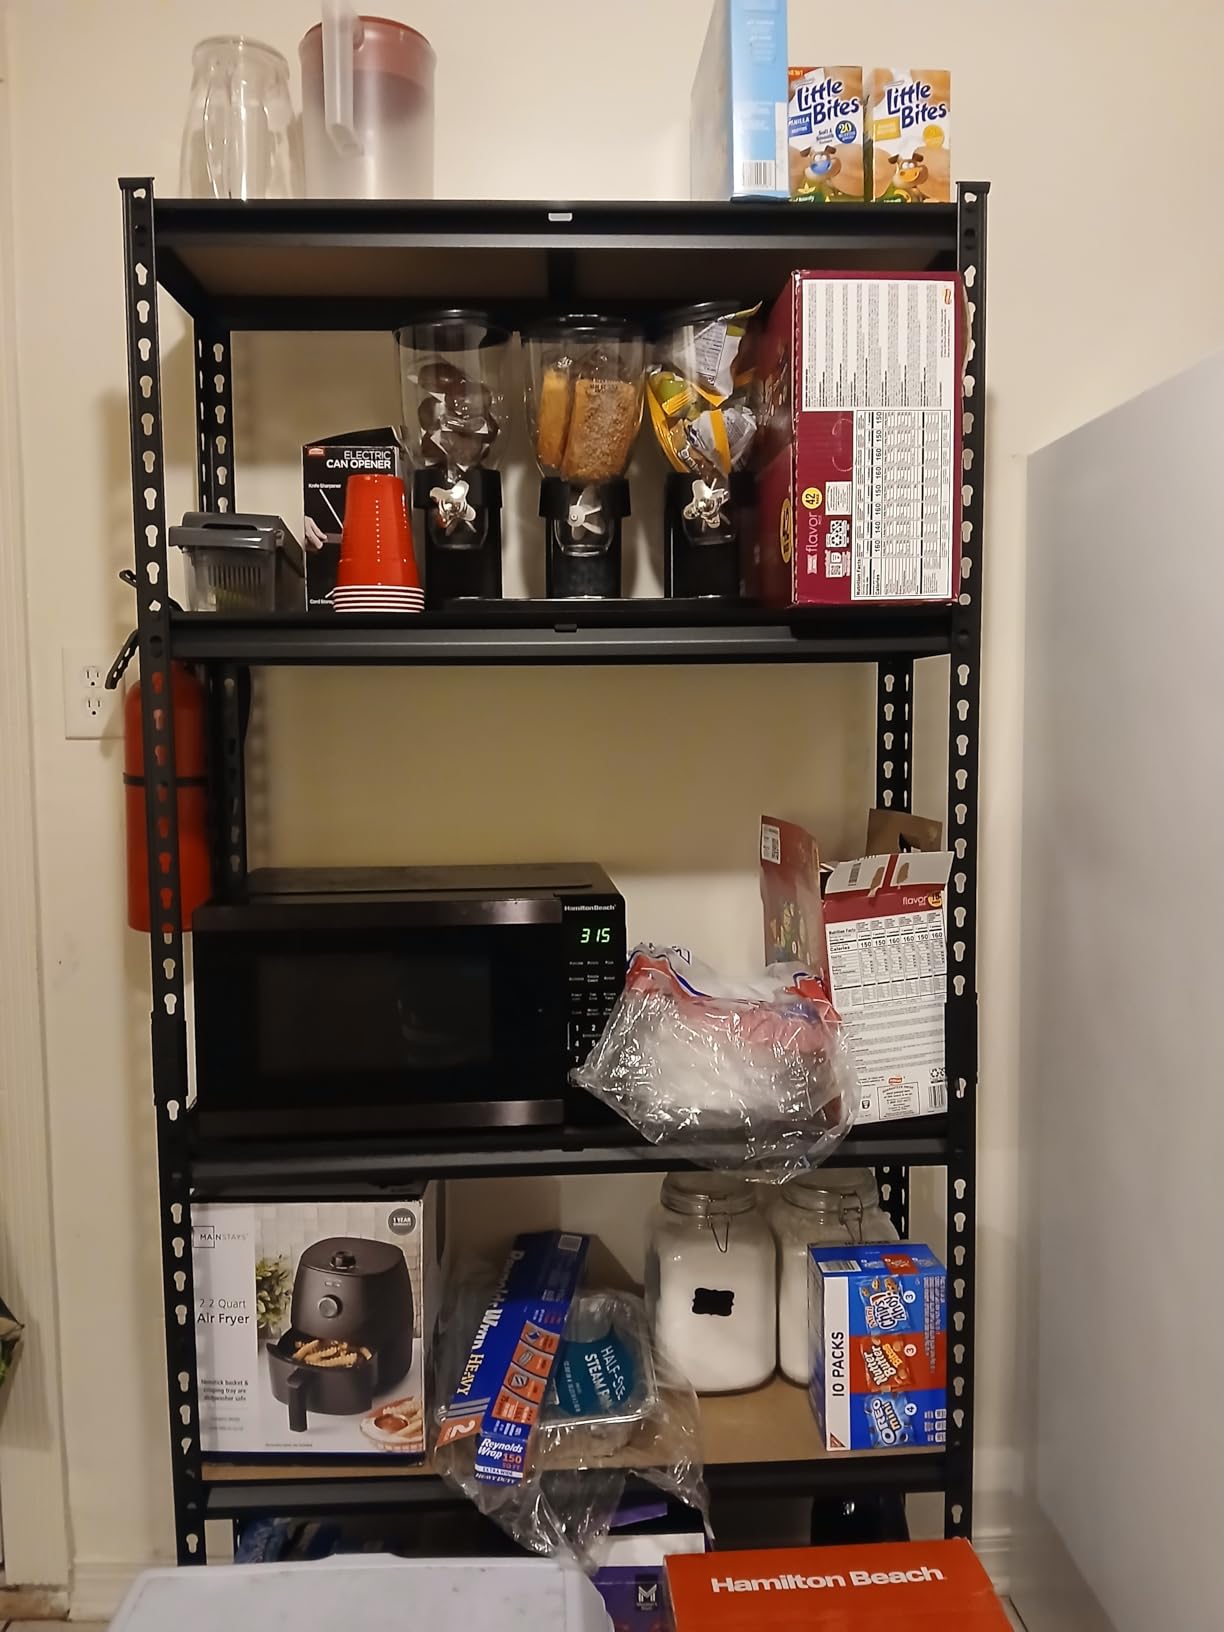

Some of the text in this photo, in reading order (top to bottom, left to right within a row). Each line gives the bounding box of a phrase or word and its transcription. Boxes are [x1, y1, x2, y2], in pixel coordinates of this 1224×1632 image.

[797, 78, 842, 112] Little
[887, 82, 931, 115] Little
[814, 98, 859, 125] Bites
[902, 103, 947, 128] Bites
[326, 459, 391, 469] CAN OPENER
[344, 450, 391, 460] ELECTRIC
[806, 494, 816, 504] 42
[806, 512, 818, 552] flavor
[902, 896, 927, 904] flavor
[218, 1299, 246, 1309] Quart
[875, 1300, 897, 1329] Chips
[197, 1313, 250, 1326] Air Fryer
[832, 1332, 844, 1396] 10 PACKS
[872, 1345, 897, 1377] Butter
[882, 1343, 903, 1368] Bites
[456, 1354, 484, 1396] HEAVY
[585, 1353, 608, 1391] STEAM
[864, 1352, 888, 1386] Nutter
[872, 1399, 896, 1444] OREO
[882, 1401, 900, 1430] mini
[478, 1446, 502, 1460] Wrap
[481, 1438, 524, 1453] Reynolds
[503, 1453, 522, 1464] 150
[711, 1566, 944, 1592] Hamilton Beach
